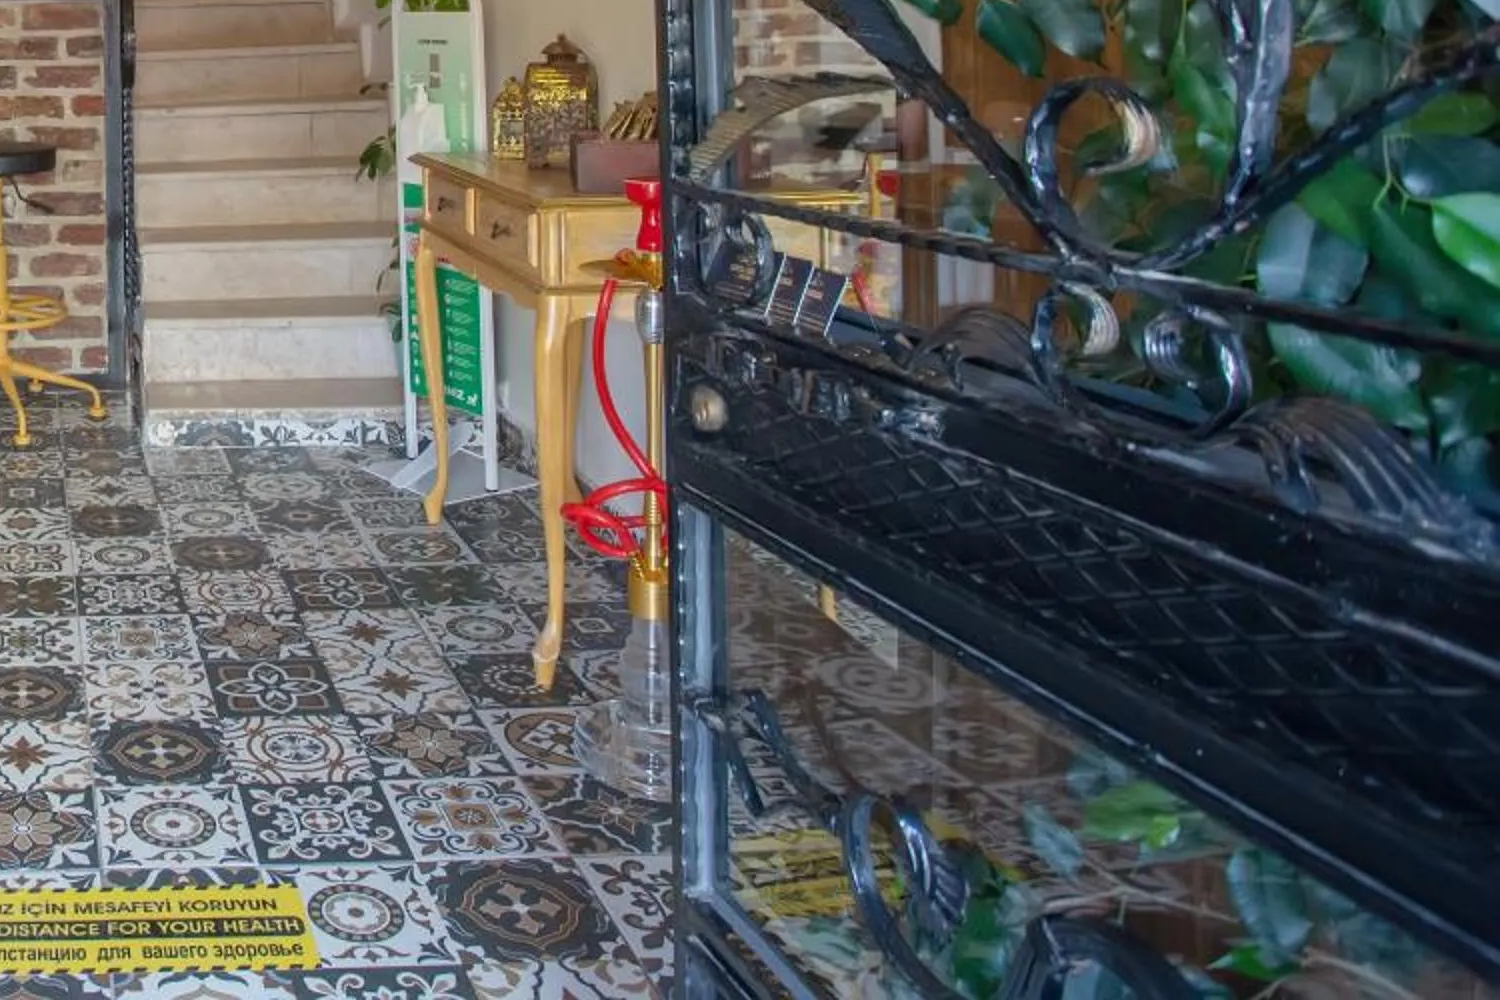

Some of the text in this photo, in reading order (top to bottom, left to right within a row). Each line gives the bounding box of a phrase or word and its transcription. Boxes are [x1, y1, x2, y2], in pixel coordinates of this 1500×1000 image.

[21, 901, 67, 918] İÇİN
[179, 898, 278, 913] KORUYUN
[107, 921, 151, 936] FOR
[154, 920, 216, 935] YOUR
[222, 918, 301, 934] HEALTH
